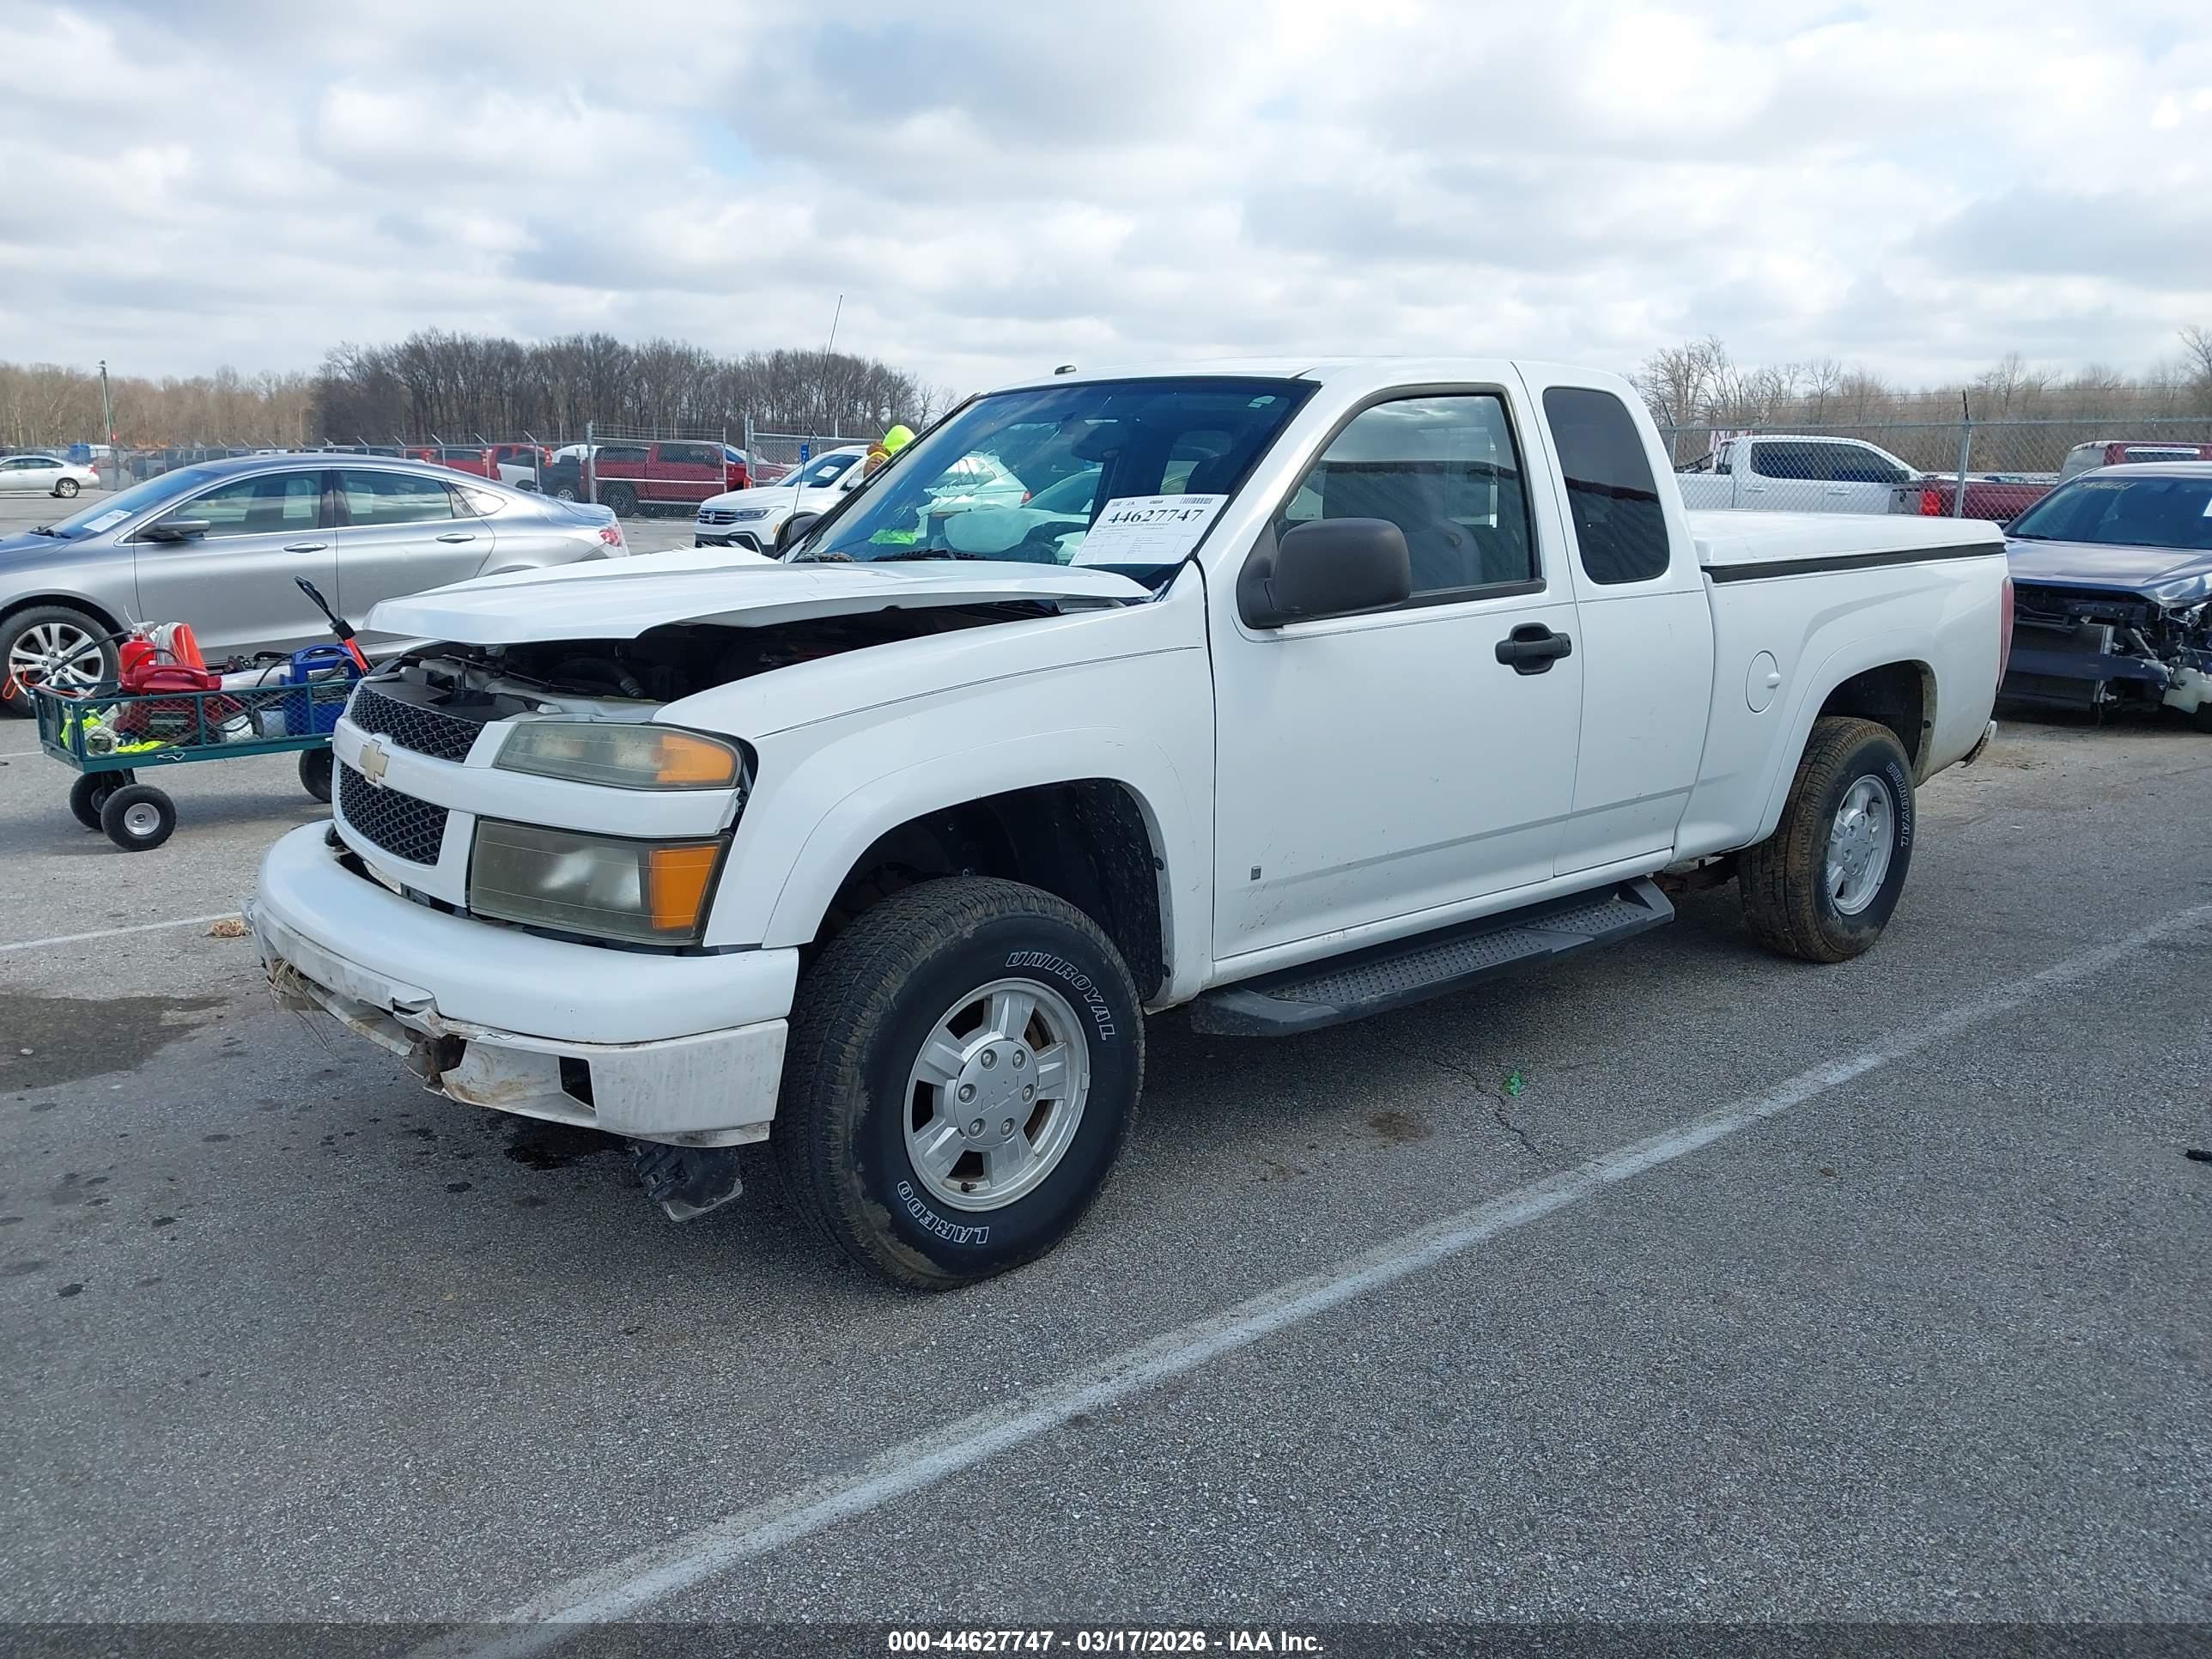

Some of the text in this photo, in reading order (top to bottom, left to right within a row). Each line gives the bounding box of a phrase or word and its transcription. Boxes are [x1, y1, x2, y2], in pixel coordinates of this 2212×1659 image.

[1108, 508, 1205, 524] 44627747
[1886, 763, 1911, 847] UNIROYAL
[1005, 951, 1117, 1041] UNIROYAL
[896, 1179, 990, 1245] LAREDO
